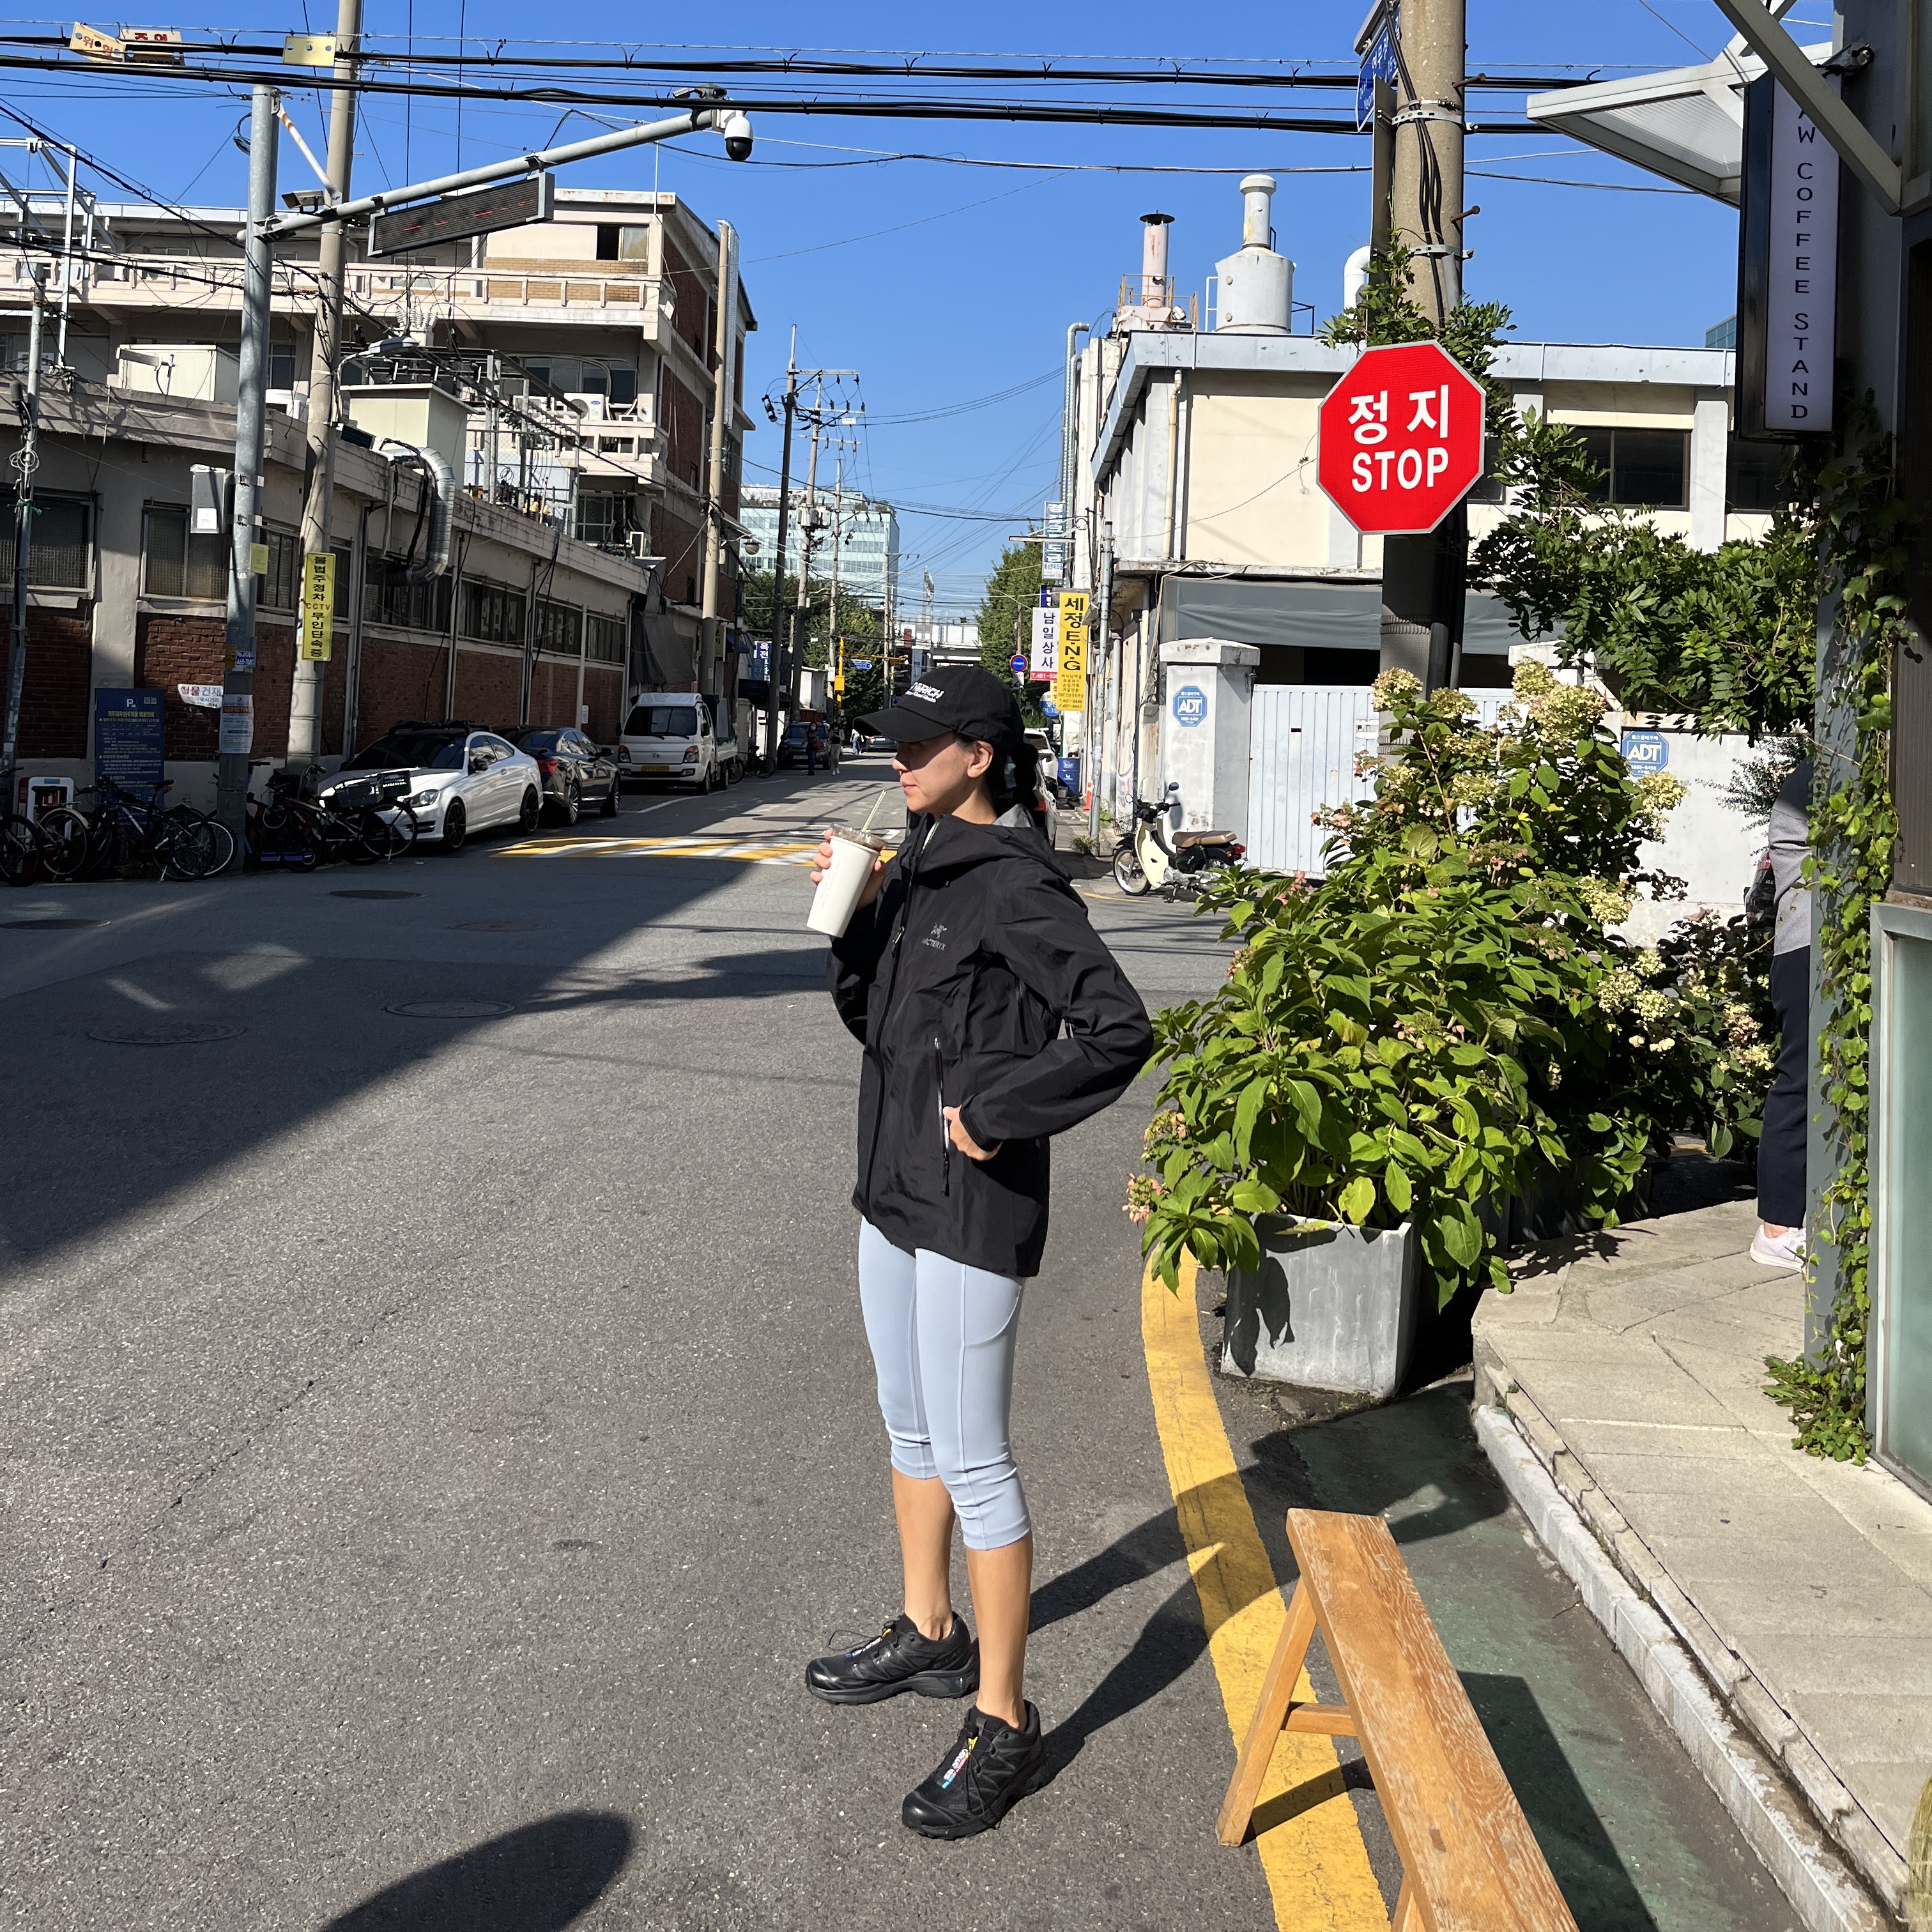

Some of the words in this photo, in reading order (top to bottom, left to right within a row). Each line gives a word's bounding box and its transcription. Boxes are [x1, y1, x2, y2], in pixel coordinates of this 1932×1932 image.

[1795, 162, 1814, 294] COFFEE
[1790, 312, 1809, 419] STAND
[1351, 447, 1449, 493] STOP
[312, 556, 326, 602] 불법주정차
[306, 602, 331, 611] CCTV
[310, 612, 325, 657] 무인단속중
[1041, 613, 1055, 669] 남일상사
[1178, 699, 1202, 714] ADT
[1627, 744, 1661, 761] ADT
